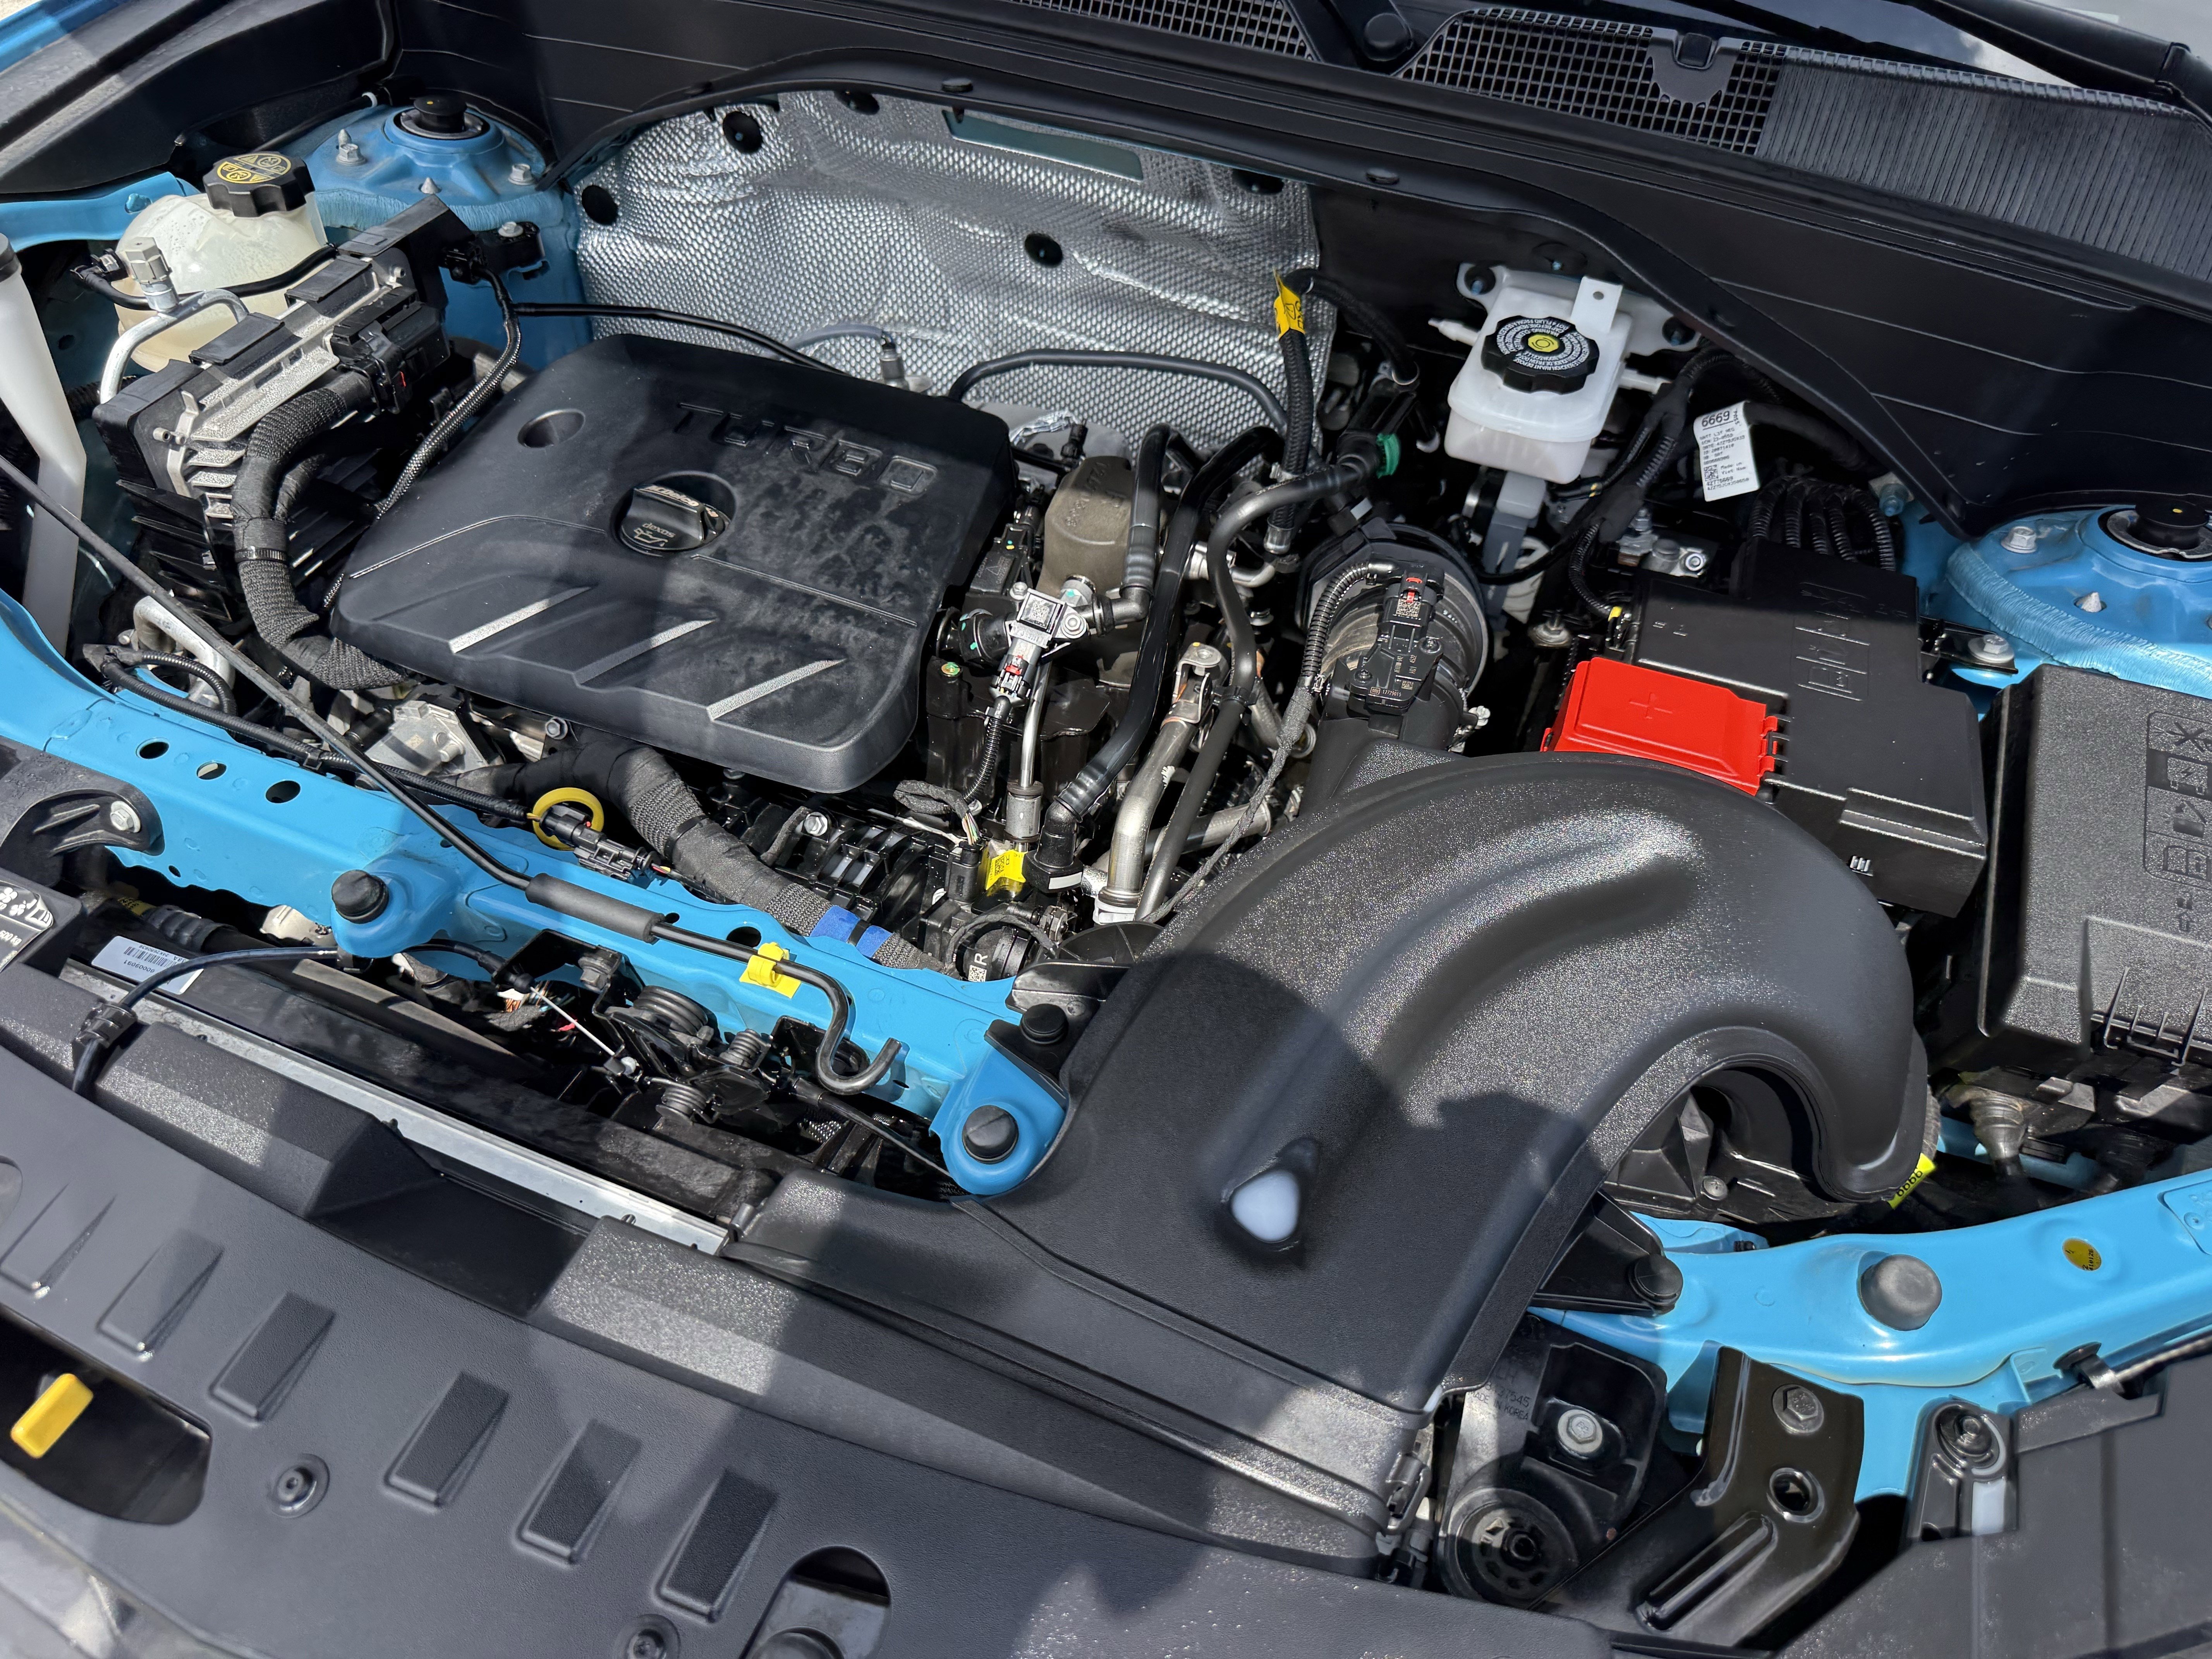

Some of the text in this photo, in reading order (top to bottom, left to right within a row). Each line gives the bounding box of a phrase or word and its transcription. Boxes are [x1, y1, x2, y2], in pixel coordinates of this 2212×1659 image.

[1702, 411, 1730, 427] 6669
[675, 402, 939, 496] TURBO
[642, 522, 676, 538] dexos
[10, 935, 22, 946] kg
[974, 953, 988, 966] R
[1468, 1391, 1489, 1405] MADE
[1504, 1405, 1529, 1420] KOREA
